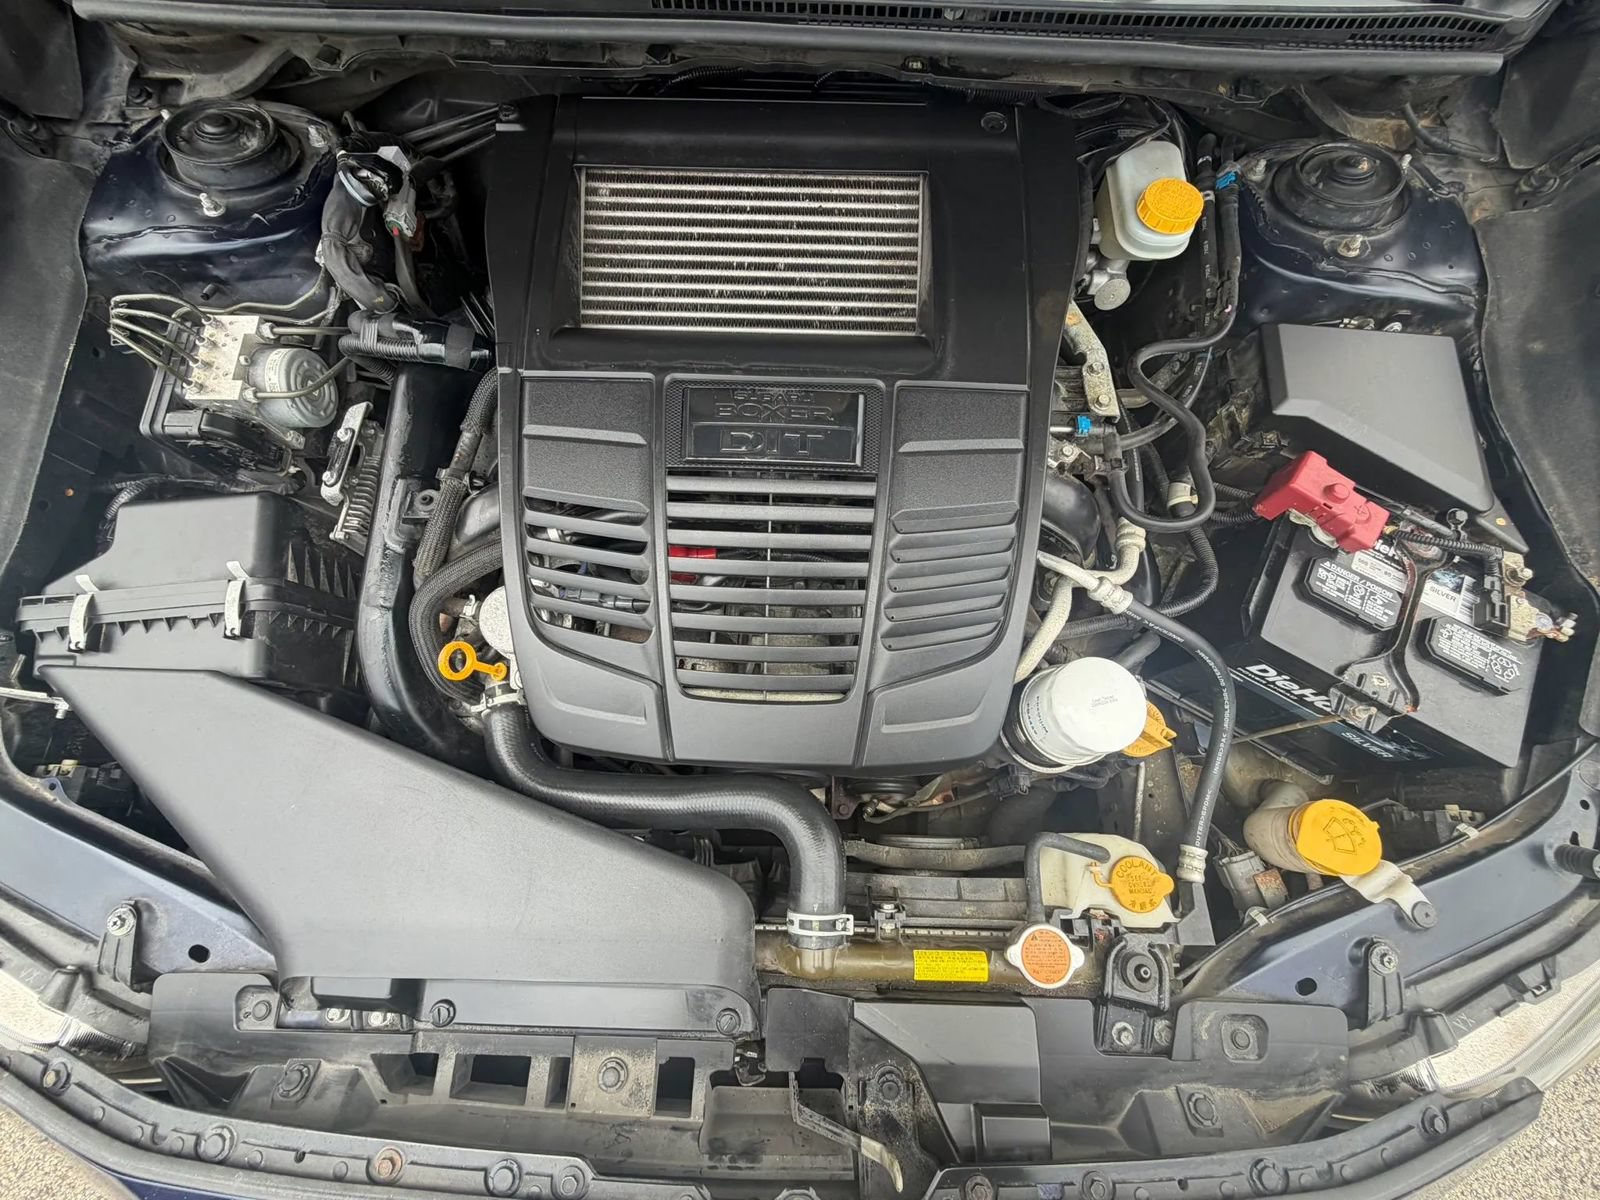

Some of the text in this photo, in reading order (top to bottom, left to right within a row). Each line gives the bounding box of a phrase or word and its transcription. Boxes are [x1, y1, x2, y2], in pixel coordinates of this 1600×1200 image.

[714, 402, 835, 421] BOXER
[719, 431, 826, 455] DIT
[1330, 563, 1361, 582] DANGER
[1366, 580, 1395, 599] POISON
[1429, 585, 1457, 603] SILVER
[1341, 731, 1394, 758] SILVER
[1115, 860, 1159, 879] COOLANT
